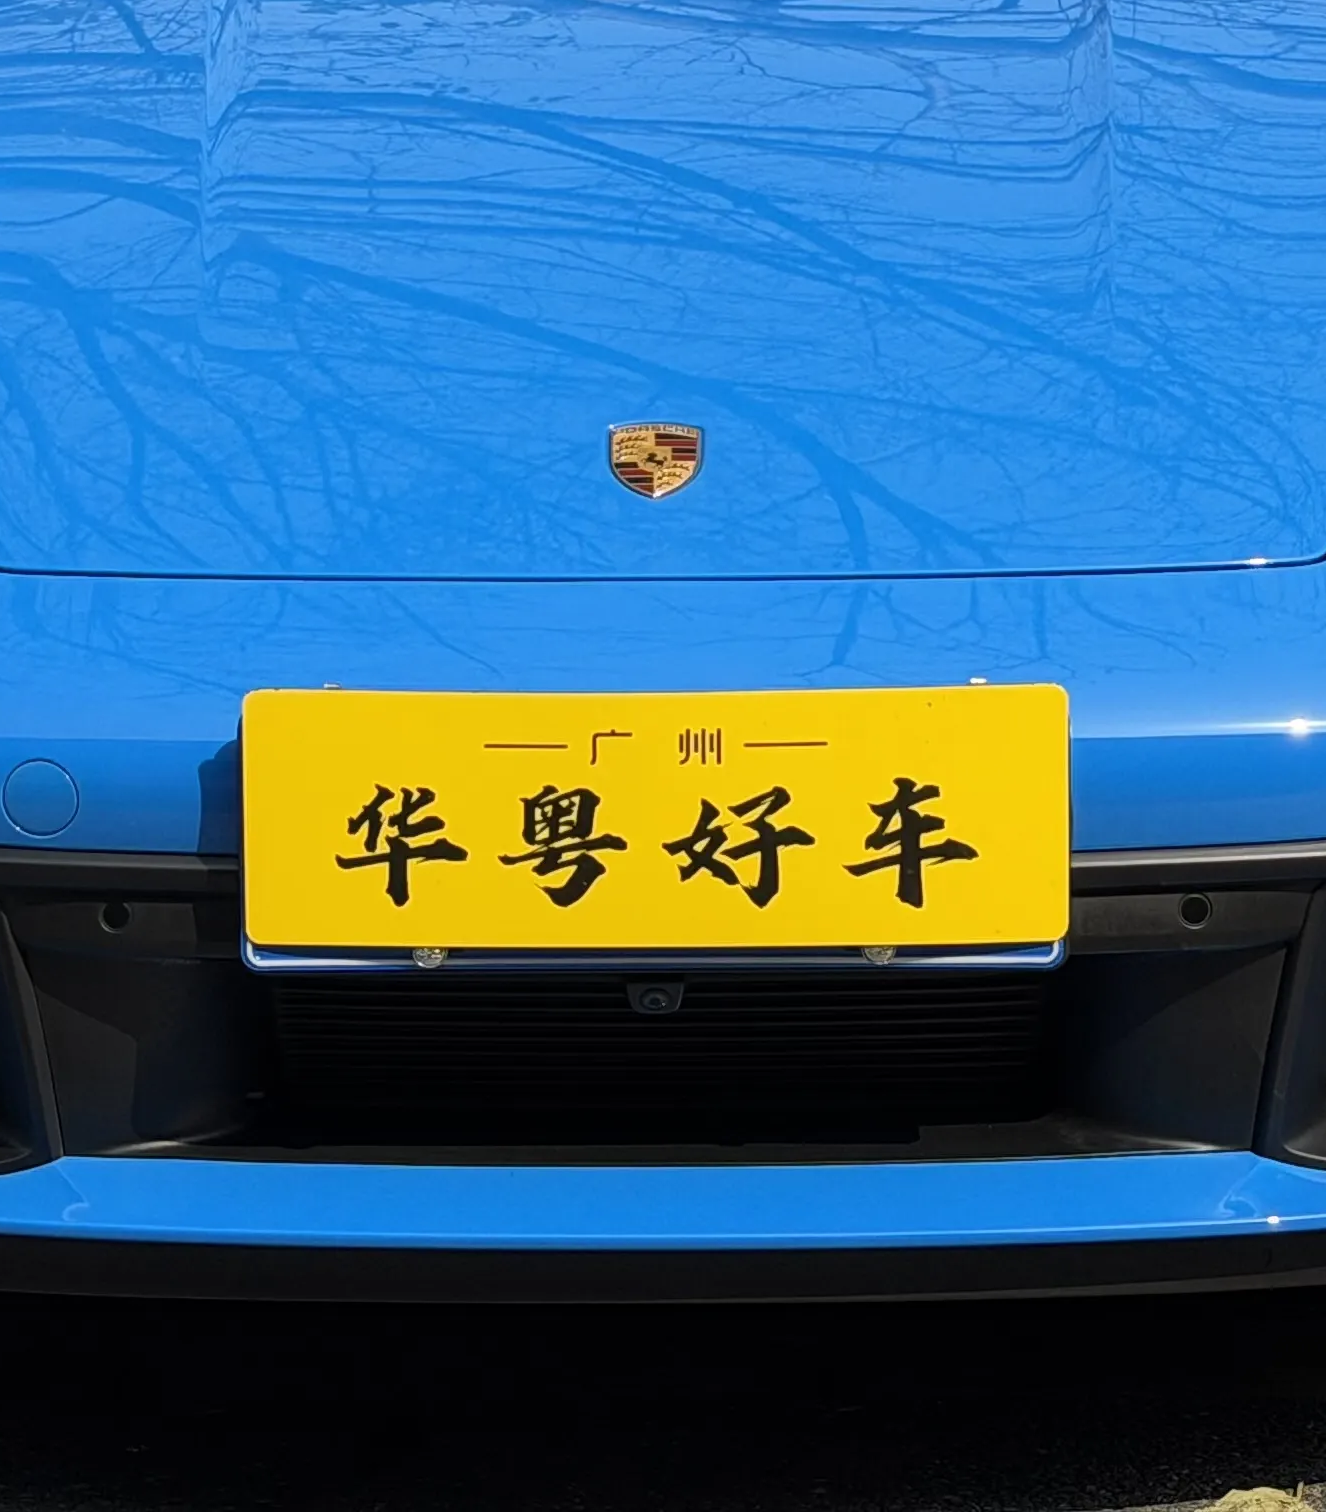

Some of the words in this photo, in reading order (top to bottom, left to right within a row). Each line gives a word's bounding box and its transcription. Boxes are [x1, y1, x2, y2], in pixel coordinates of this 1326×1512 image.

[589, 726, 724, 767] 广州
[335, 776, 981, 909] 华粤好车
